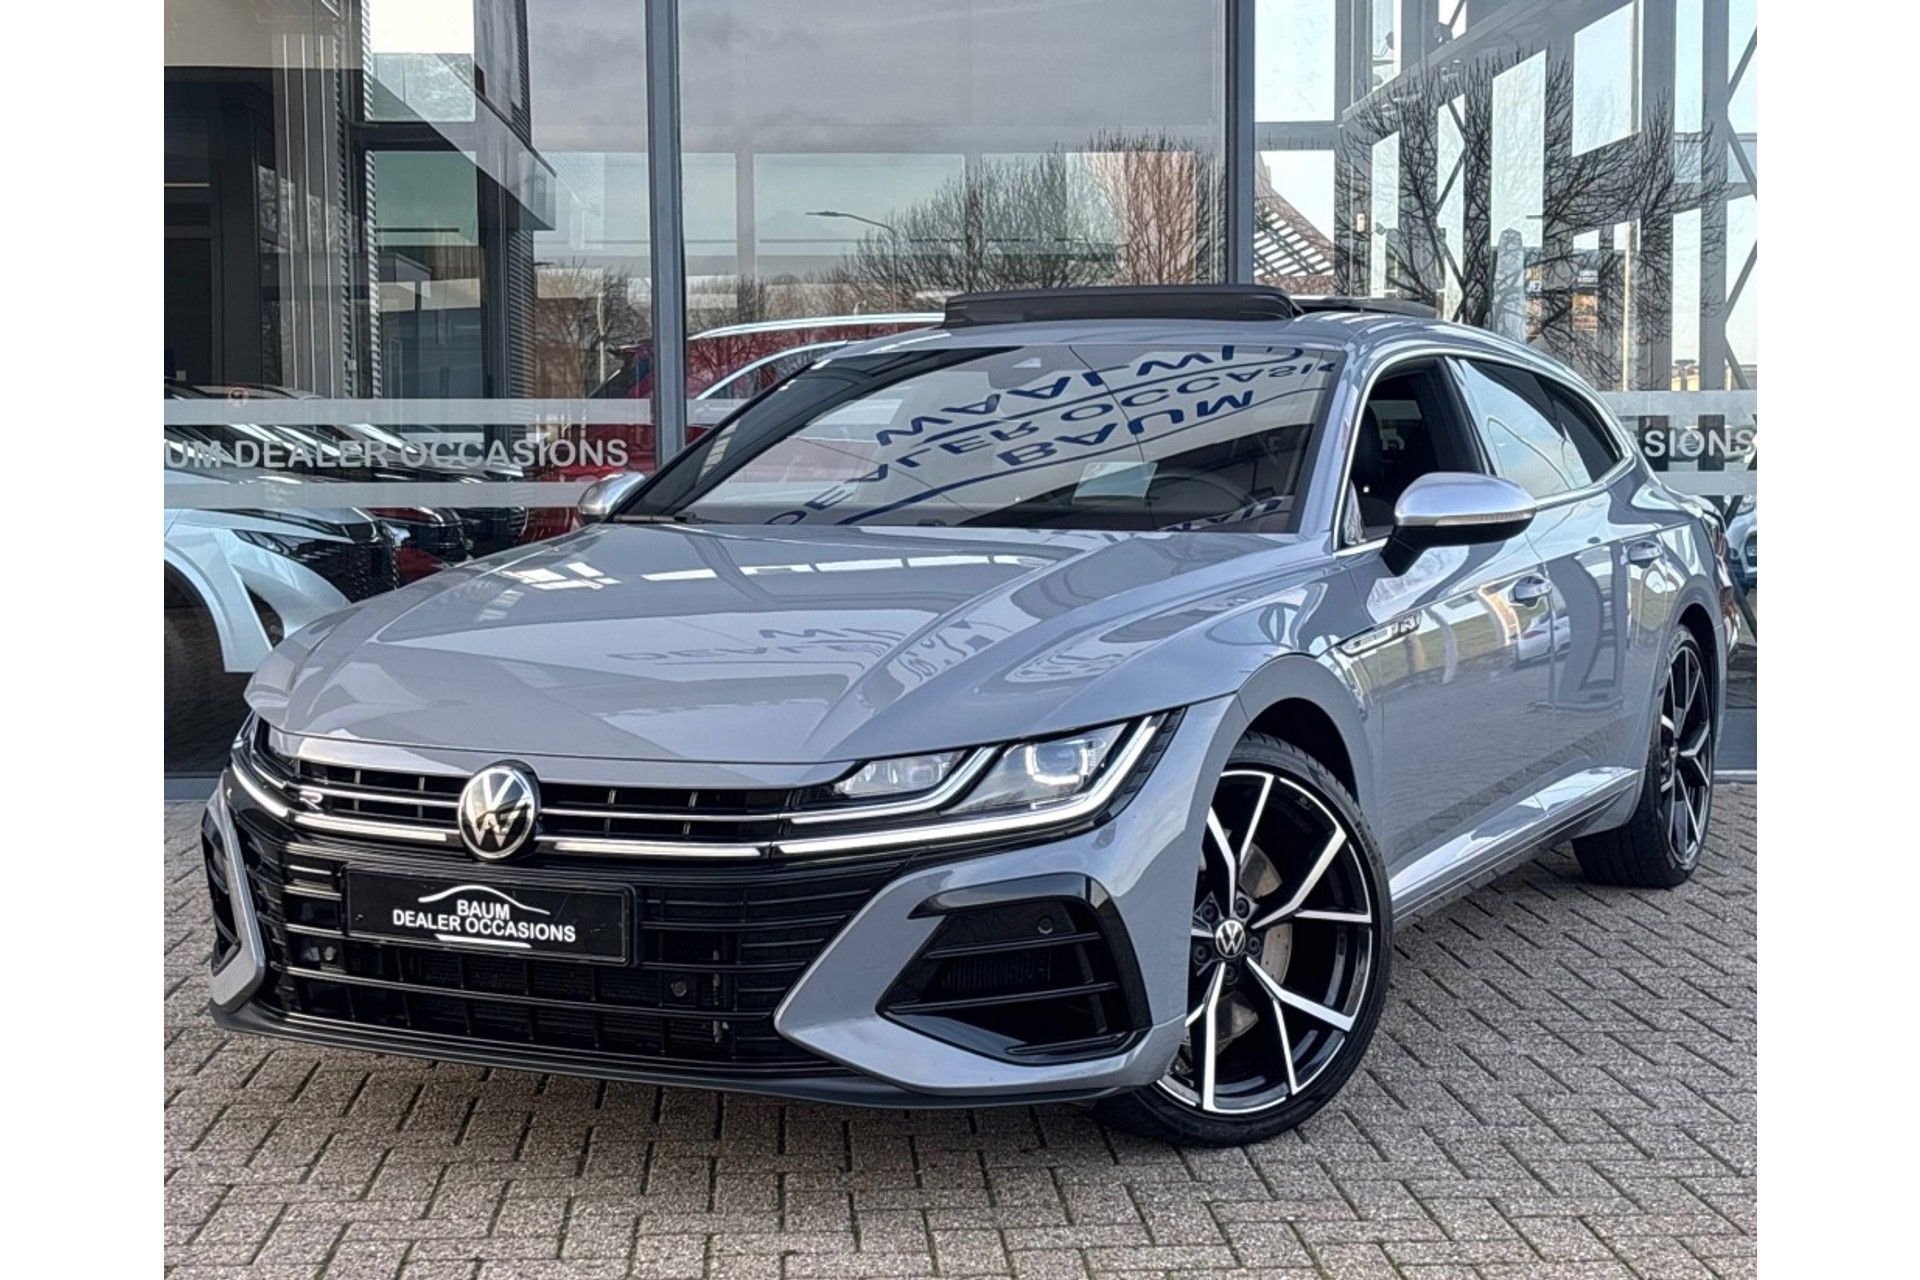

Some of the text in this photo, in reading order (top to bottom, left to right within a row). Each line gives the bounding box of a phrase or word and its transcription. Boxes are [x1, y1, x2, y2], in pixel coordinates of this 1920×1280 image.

[235, 440, 388, 468] DEALER
[400, 439, 629, 468] OCCASIONS
[456, 899, 510, 921] BAUM
[392, 909, 576, 943] DEALER OCCASIONS
